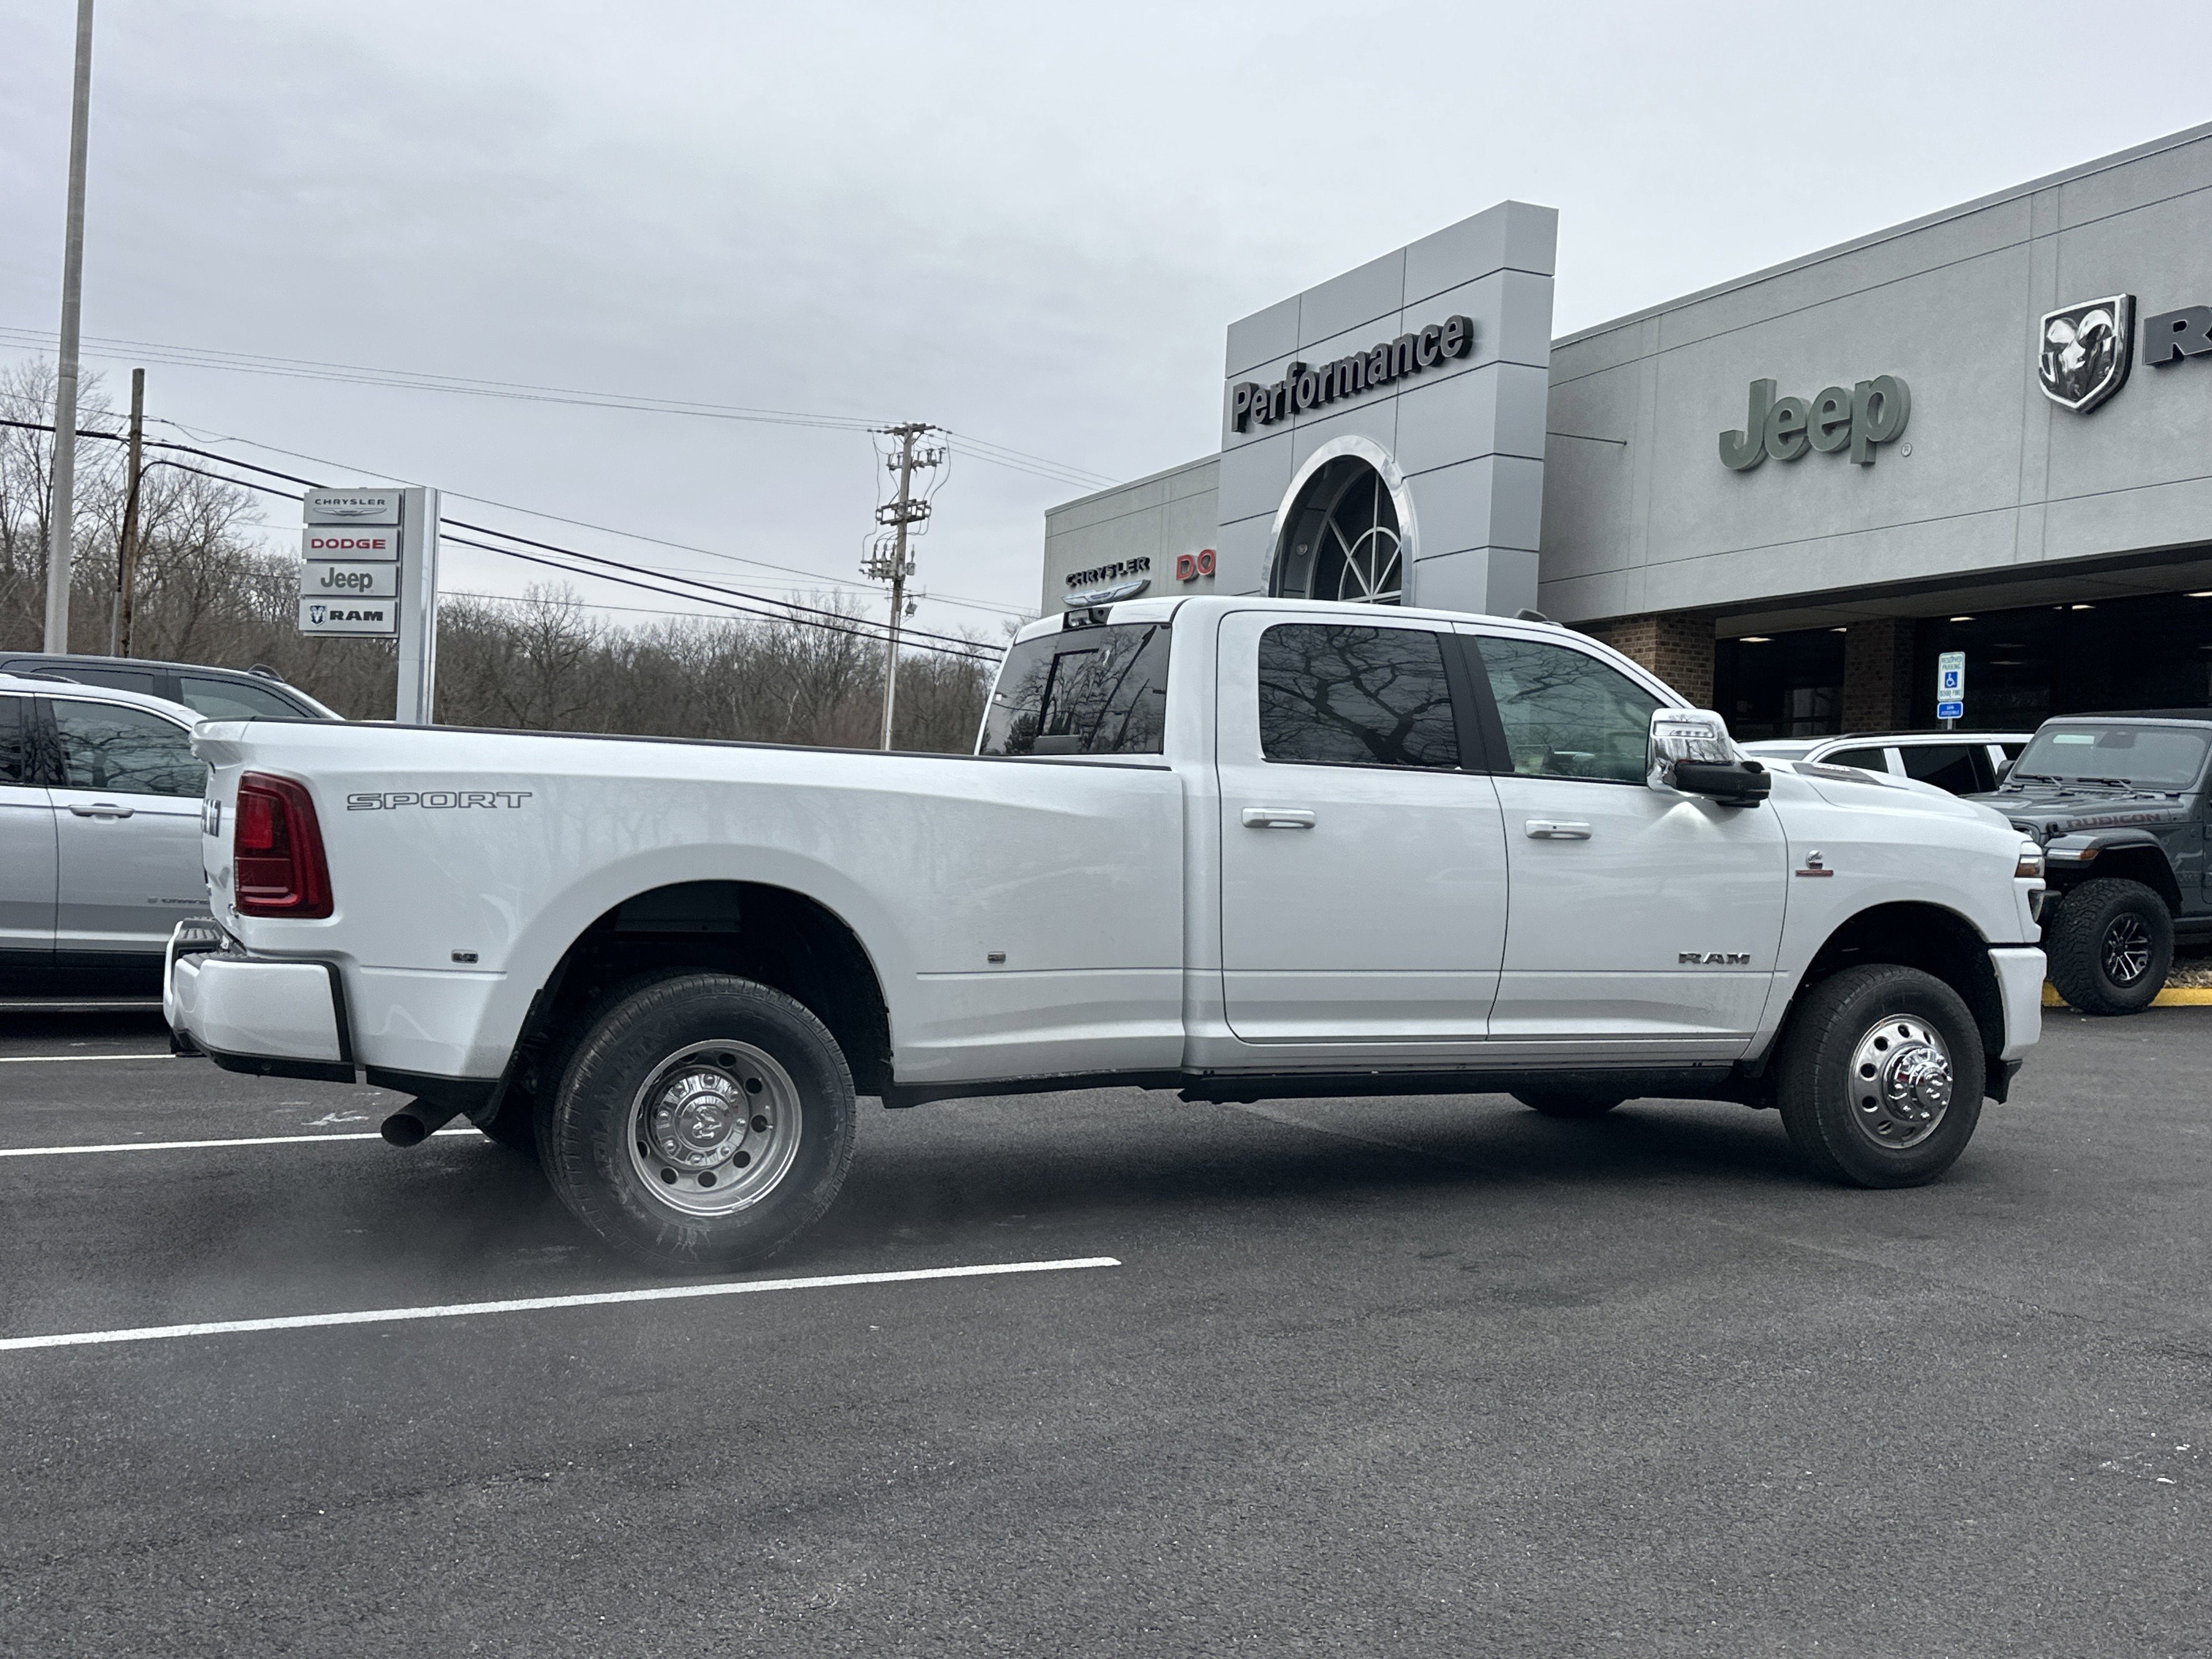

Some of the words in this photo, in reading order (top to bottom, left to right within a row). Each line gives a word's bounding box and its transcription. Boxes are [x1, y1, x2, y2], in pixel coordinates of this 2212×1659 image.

[1231, 314, 1474, 432] Performance
[1719, 375, 1911, 471] Jeep
[311, 539, 386, 549] DODGE
[320, 567, 373, 592] Jeep
[1065, 556, 1150, 587] CHRYSLER
[329, 610, 383, 621] RAM
[347, 791, 533, 811] SPORT
[2066, 813, 2161, 828] RUBICON
[1678, 951, 1751, 964] RAM
